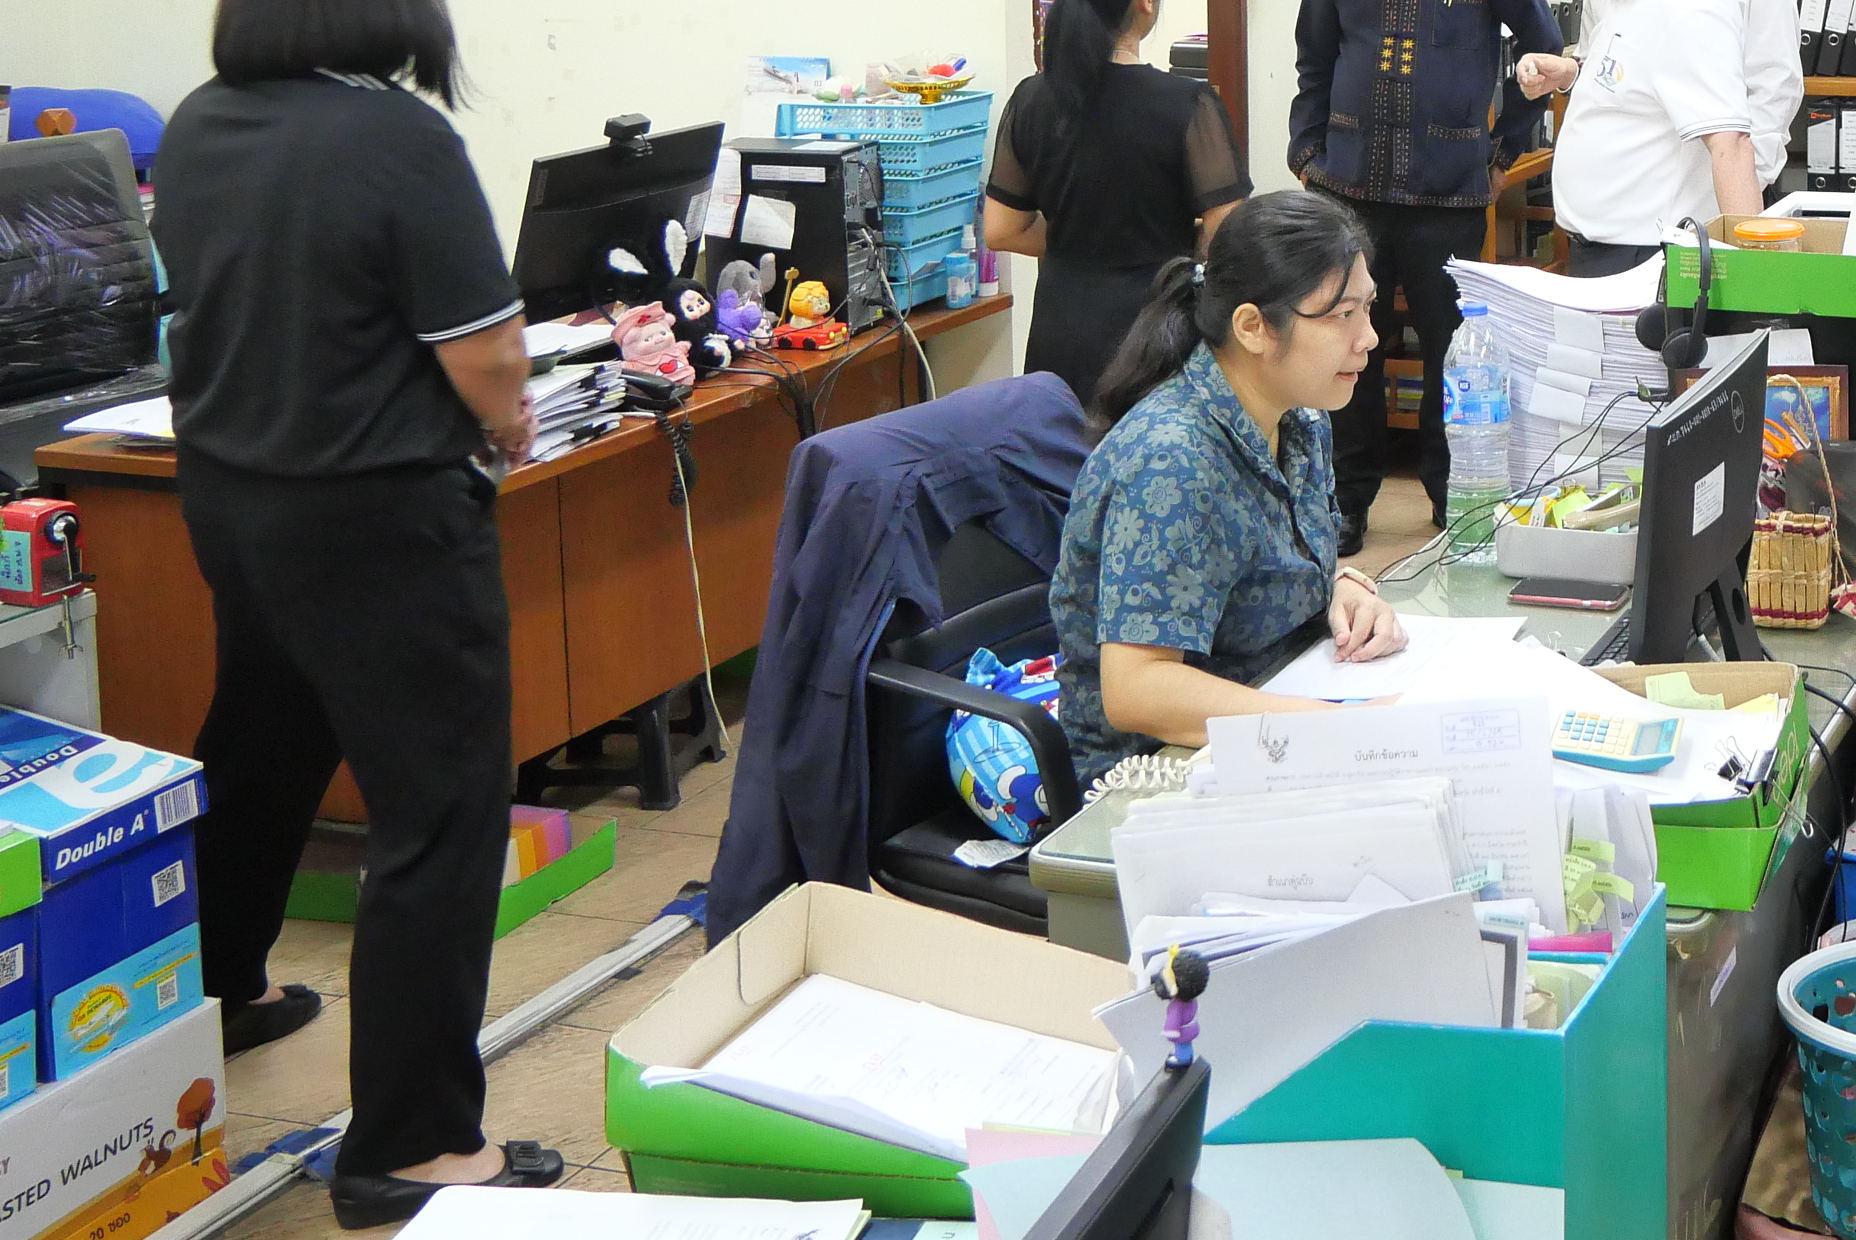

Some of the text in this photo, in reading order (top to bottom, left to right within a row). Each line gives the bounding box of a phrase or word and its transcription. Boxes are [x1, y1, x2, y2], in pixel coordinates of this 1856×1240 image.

[1353, 748, 1419, 762] บันทึกข้อความ
[55, 812, 144, 871] Double A
[60, 1117, 154, 1187] WALNUTS
